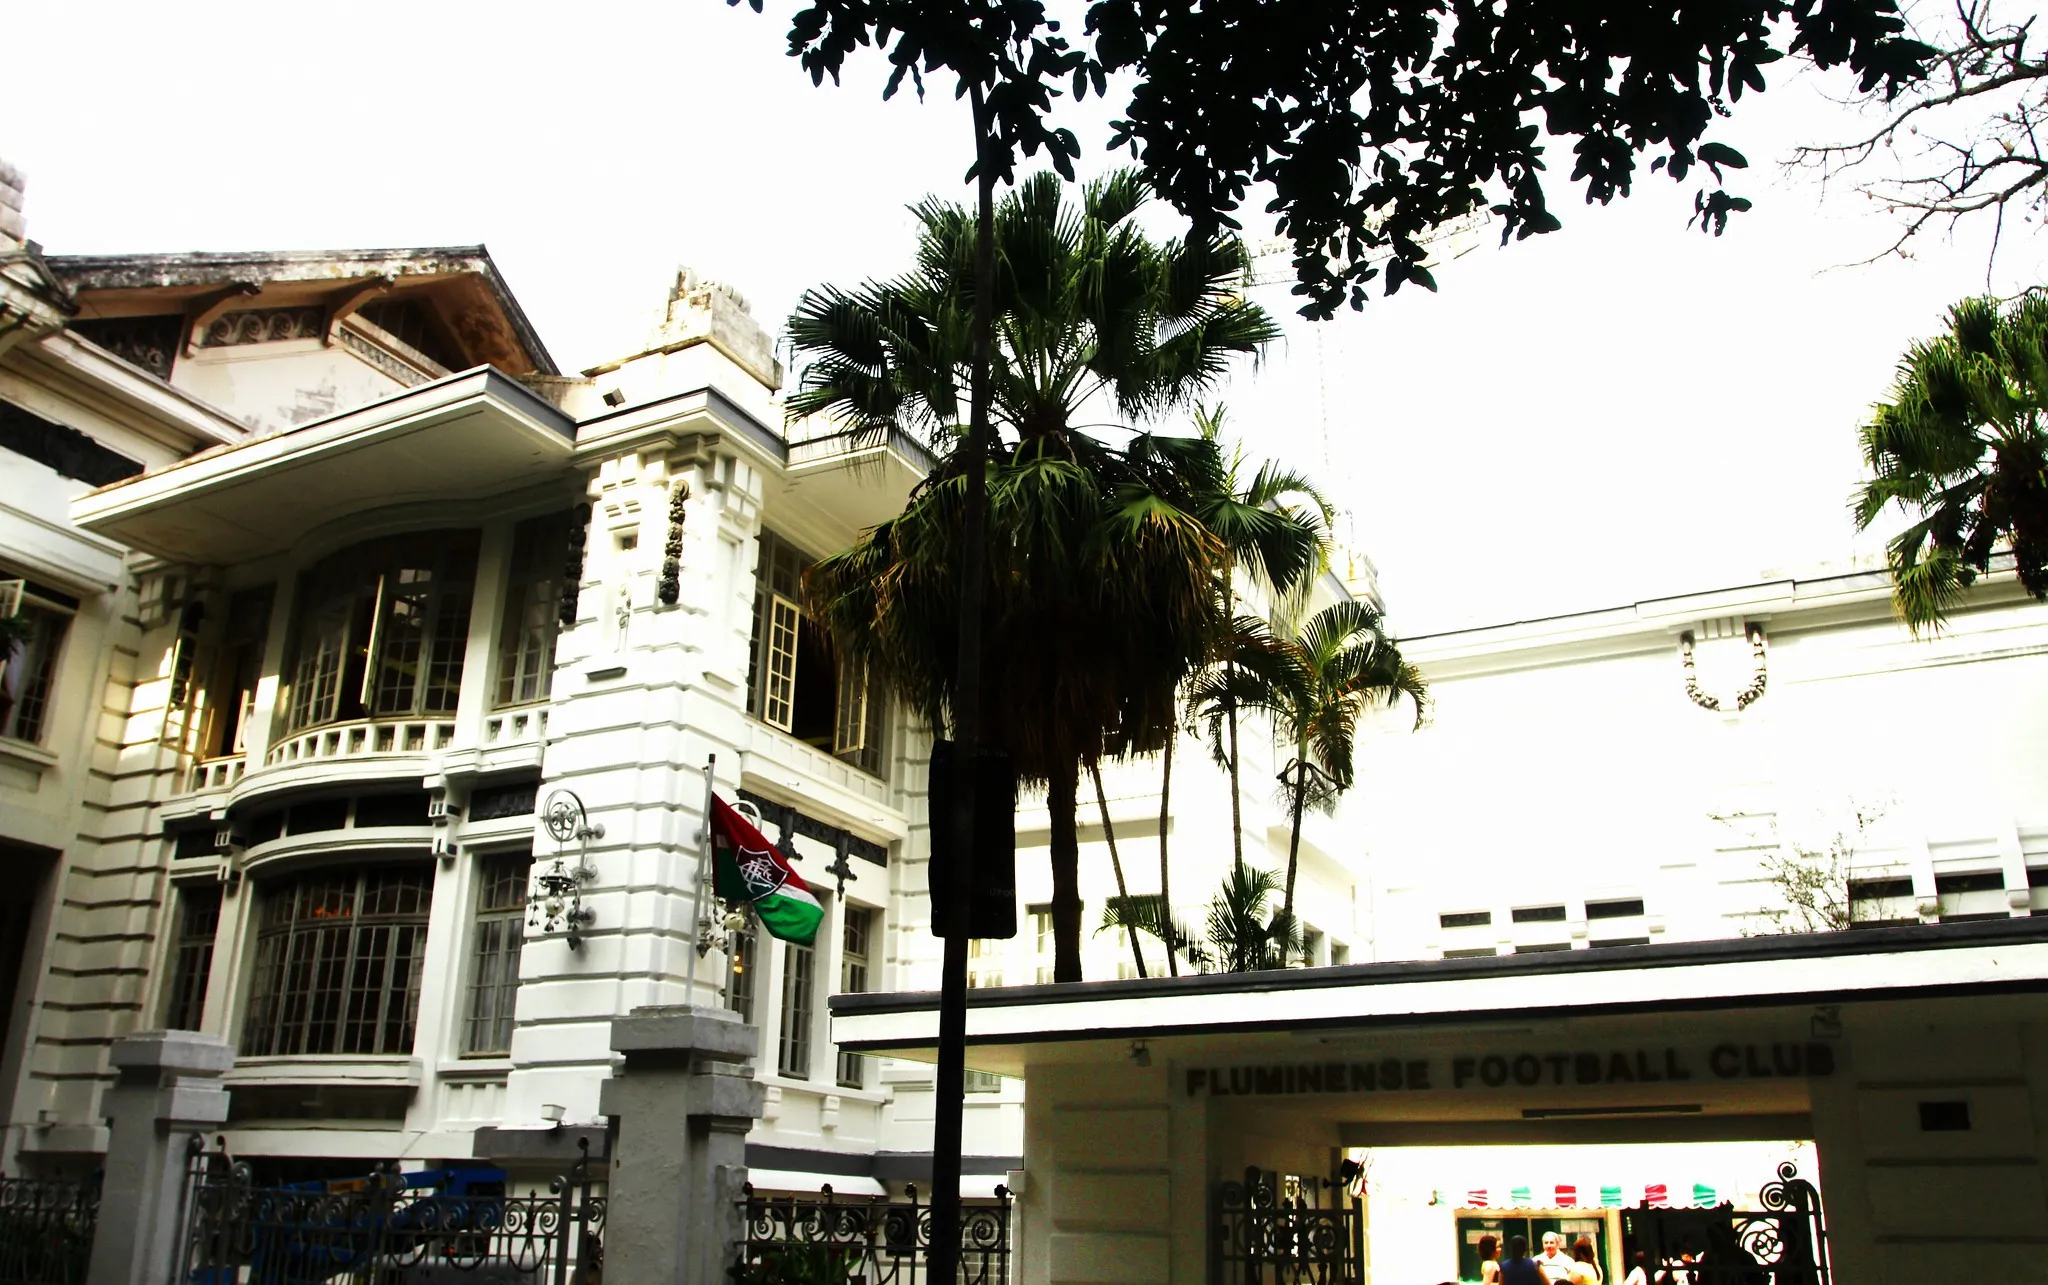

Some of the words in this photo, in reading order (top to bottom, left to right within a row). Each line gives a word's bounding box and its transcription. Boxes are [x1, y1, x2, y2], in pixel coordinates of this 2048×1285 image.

[1187, 1061, 1431, 1097] FLUMINENSE
[1454, 1047, 1691, 1088] FOOTBALL
[1711, 1043, 1836, 1078] CLUB
